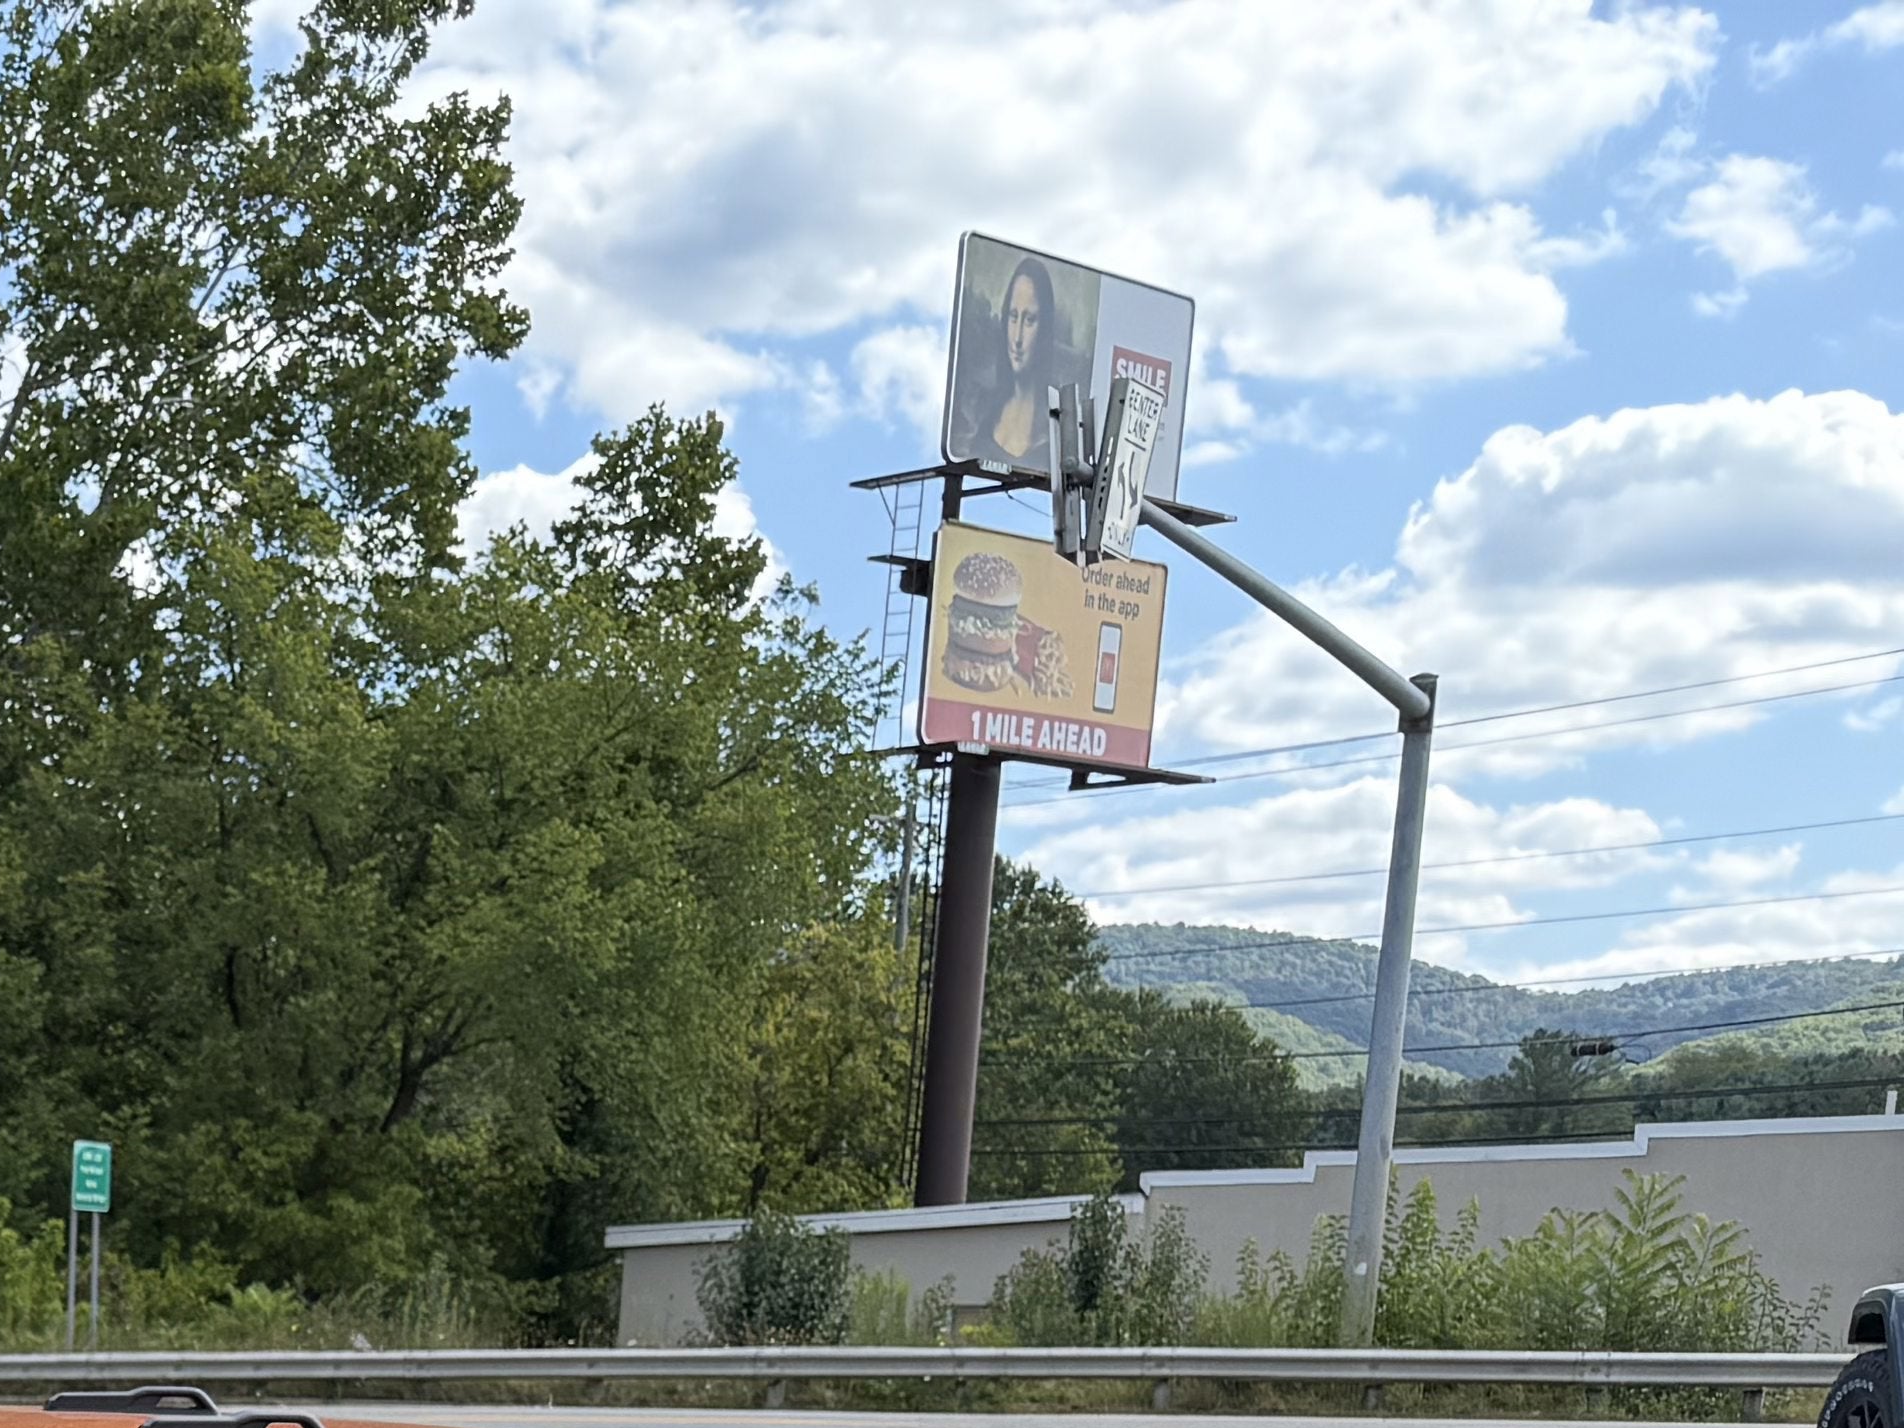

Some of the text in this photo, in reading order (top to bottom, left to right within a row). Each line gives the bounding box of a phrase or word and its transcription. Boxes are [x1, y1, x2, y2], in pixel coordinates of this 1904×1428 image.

[1115, 357, 1167, 392] SMILE
[1127, 414, 1151, 443] LANE
[1082, 566, 1151, 595] Order ahead
[1084, 588, 1140, 621] in the app
[971, 710, 1107, 757] 1 MILE AHEAD
